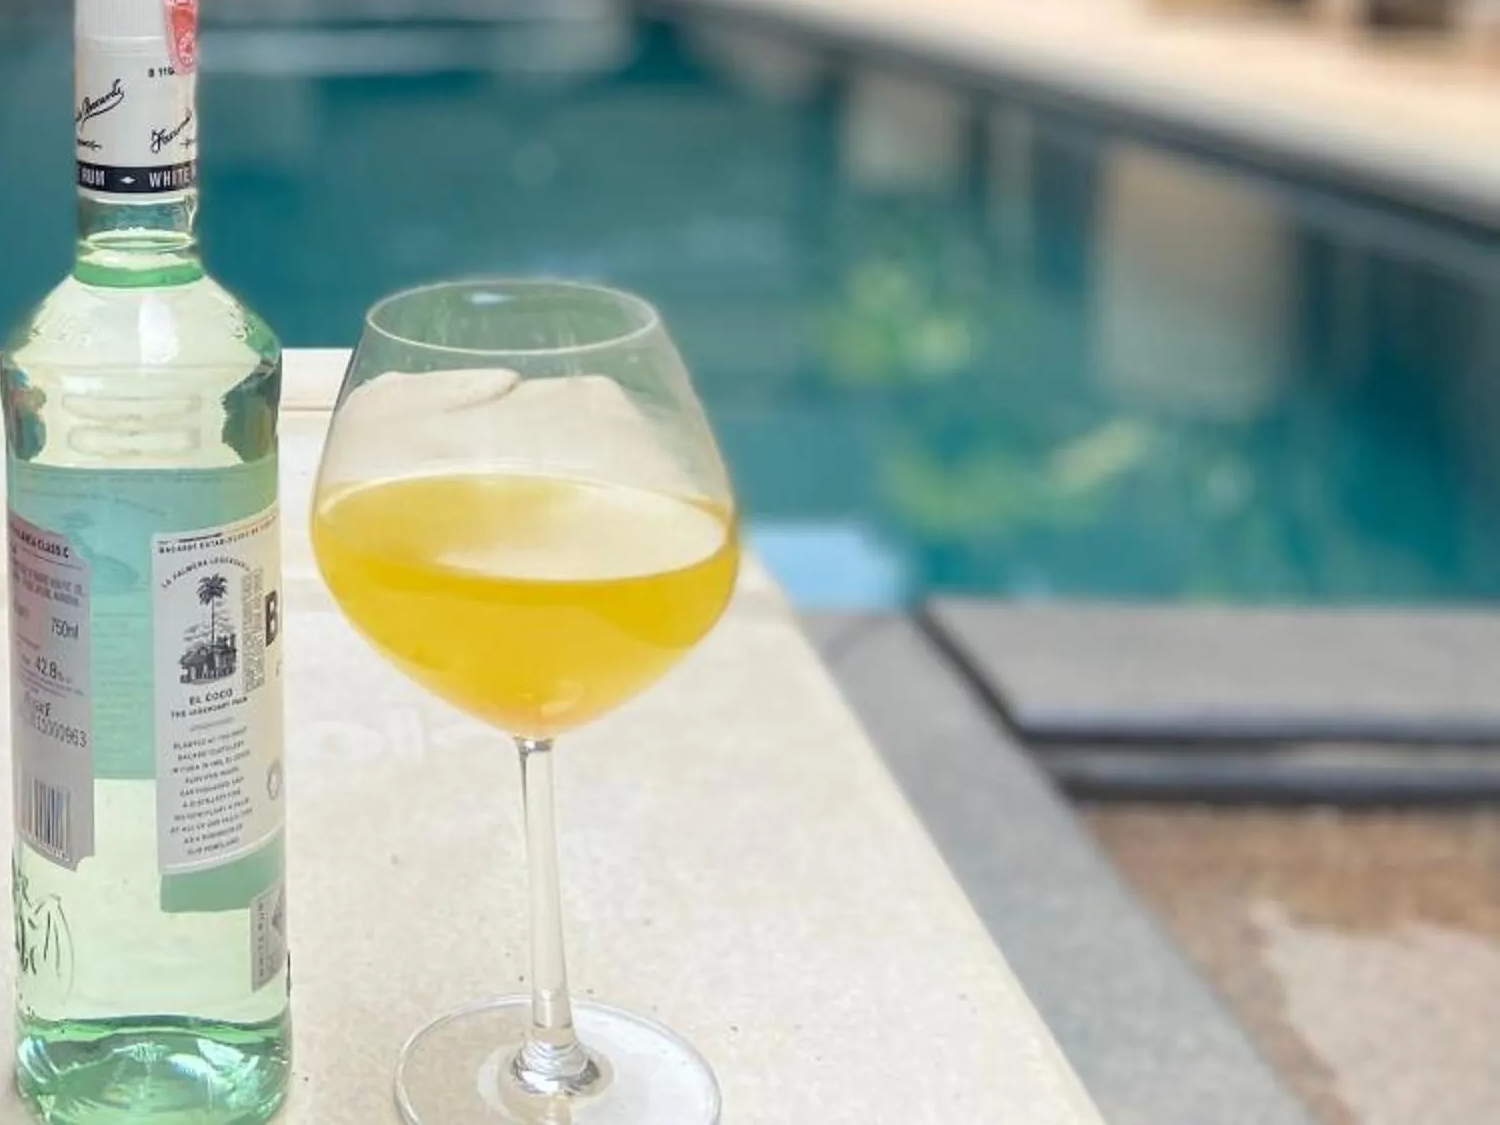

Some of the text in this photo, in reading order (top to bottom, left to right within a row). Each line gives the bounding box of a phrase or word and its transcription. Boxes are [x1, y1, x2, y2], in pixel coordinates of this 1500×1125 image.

[81, 168, 105, 187] RUM
[149, 168, 190, 188] WHITE
[205, 687, 233, 702] COCO
